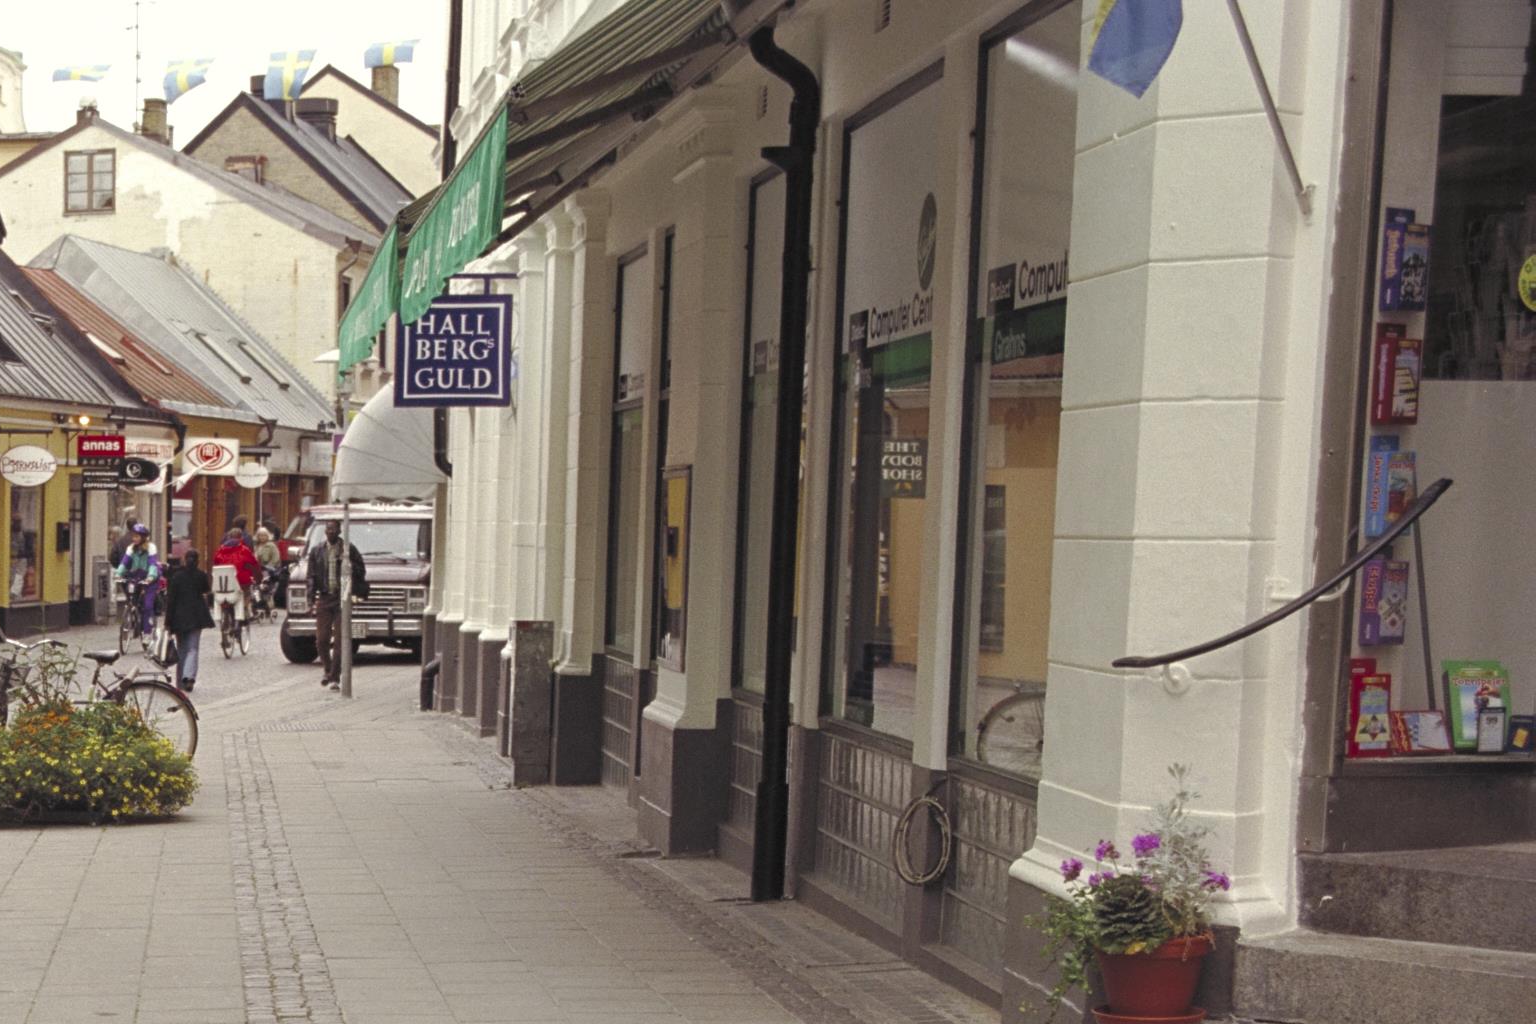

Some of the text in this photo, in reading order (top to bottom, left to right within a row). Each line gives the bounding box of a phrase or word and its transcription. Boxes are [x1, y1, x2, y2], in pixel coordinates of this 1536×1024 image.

[416, 313, 490, 335] HALL
[414, 367, 492, 390] GULD
[82, 441, 121, 452] annas
